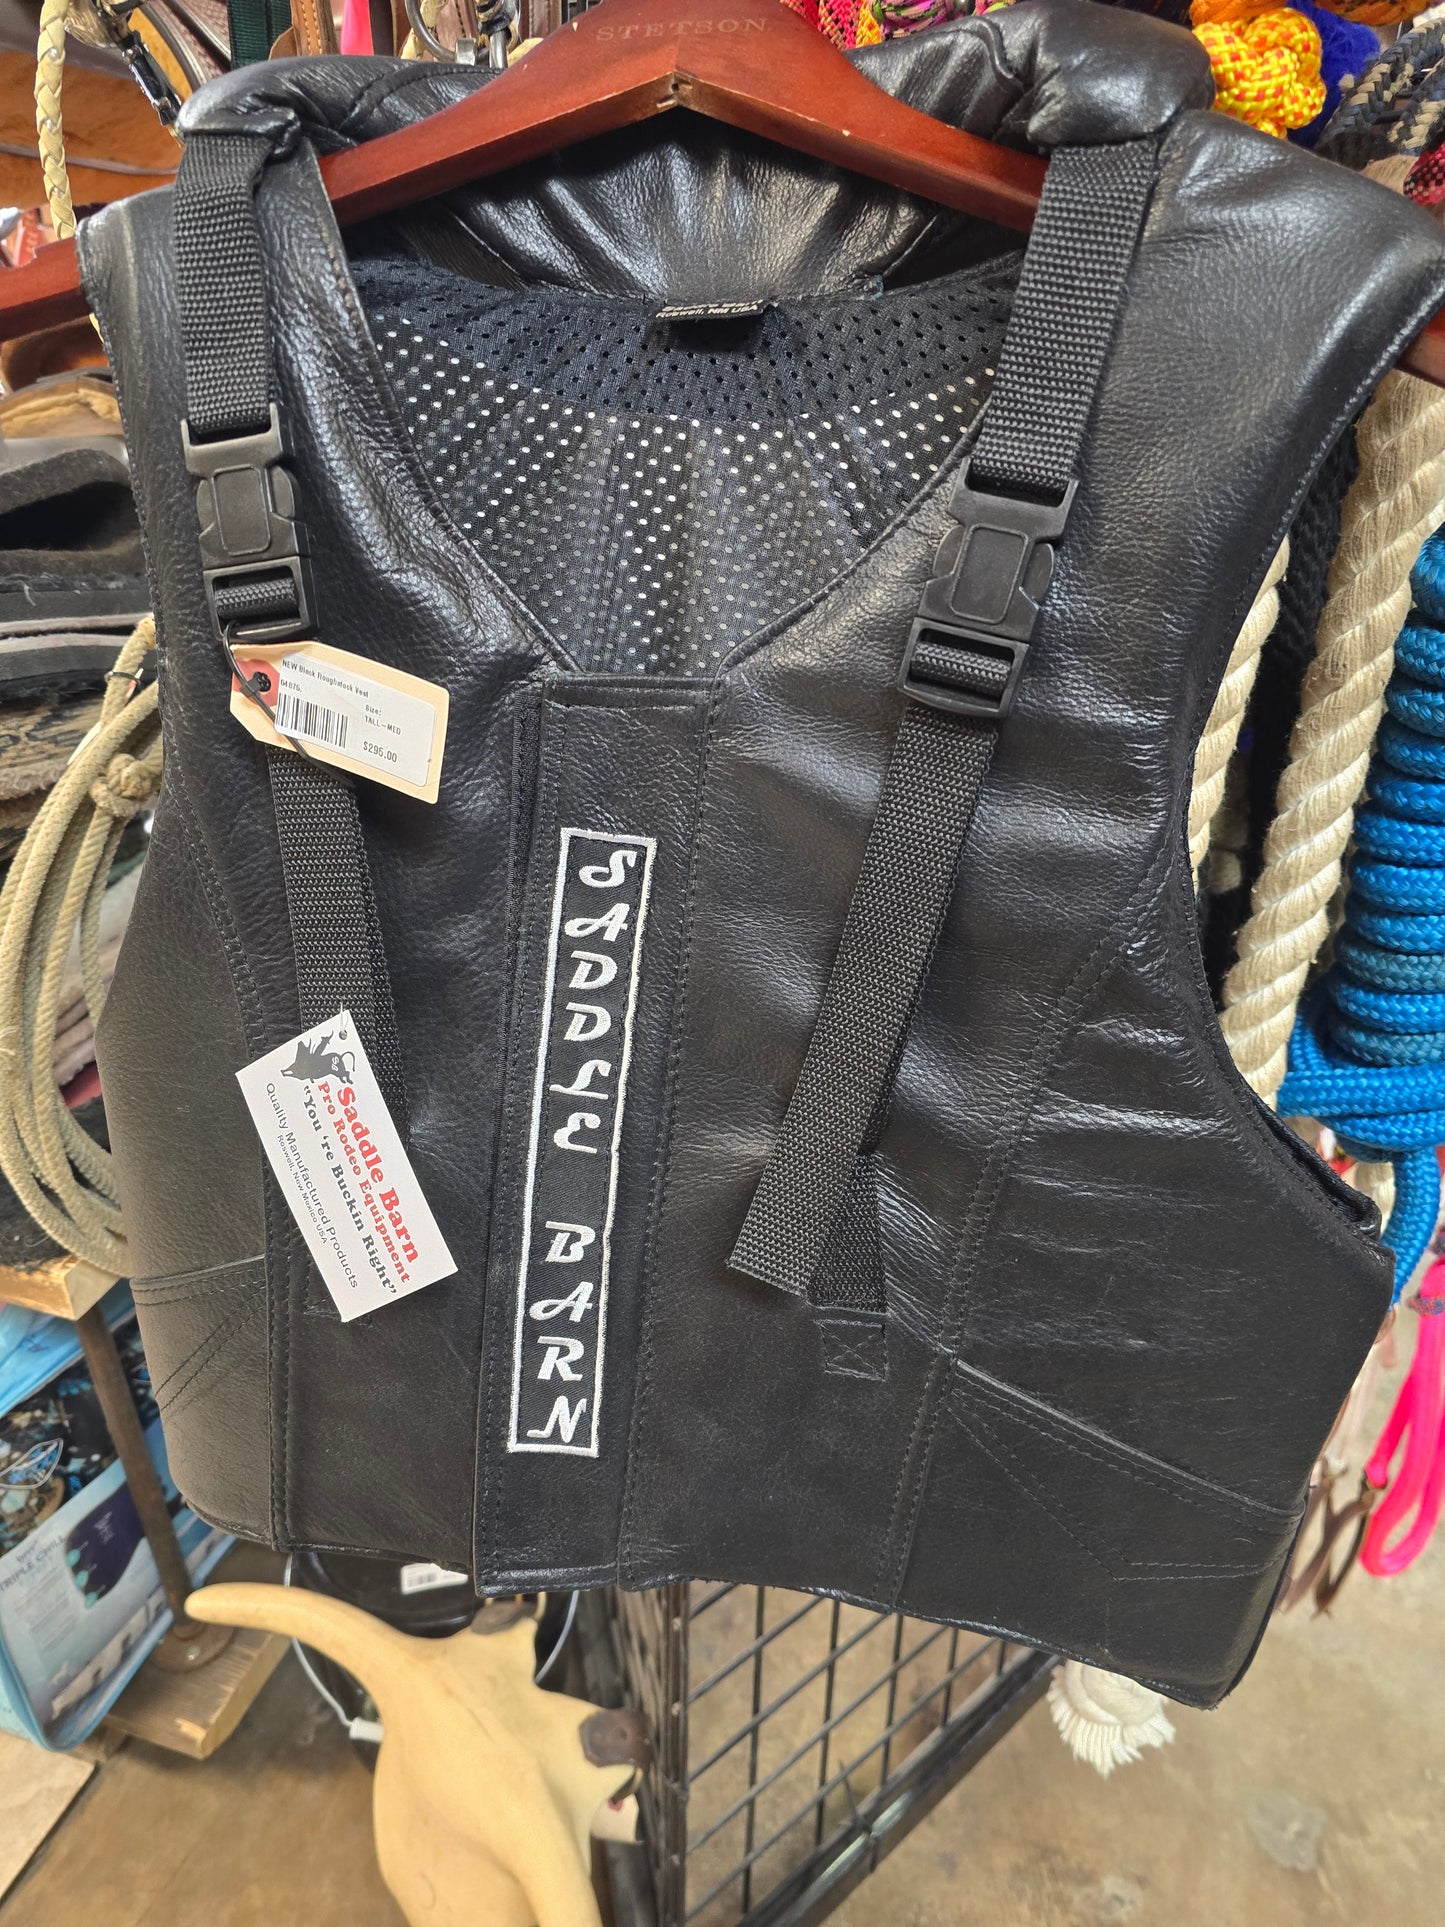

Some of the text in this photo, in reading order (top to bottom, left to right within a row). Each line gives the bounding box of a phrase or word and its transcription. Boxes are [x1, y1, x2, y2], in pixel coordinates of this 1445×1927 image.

[596, 17, 769, 42] STETSON
[282, 659, 298, 671] NEW
[355, 686, 369, 698] Vest
[365, 704, 382, 716] Size:
[363, 740, 398, 763] $295.00
[337, 1086, 419, 1262] Saddle Barn
[526, 850, 637, 1443] SADDLE BARN
[266, 1082, 358, 1288] Quality Manufactured Products
[292, 1171, 302, 1191] New
[302, 1189, 318, 1224] Mexico
[316, 1225, 328, 1244] USA
[318, 1081, 410, 1283] Pro Rodeo Equipment
[331, 1164, 364, 1231] Buckin
